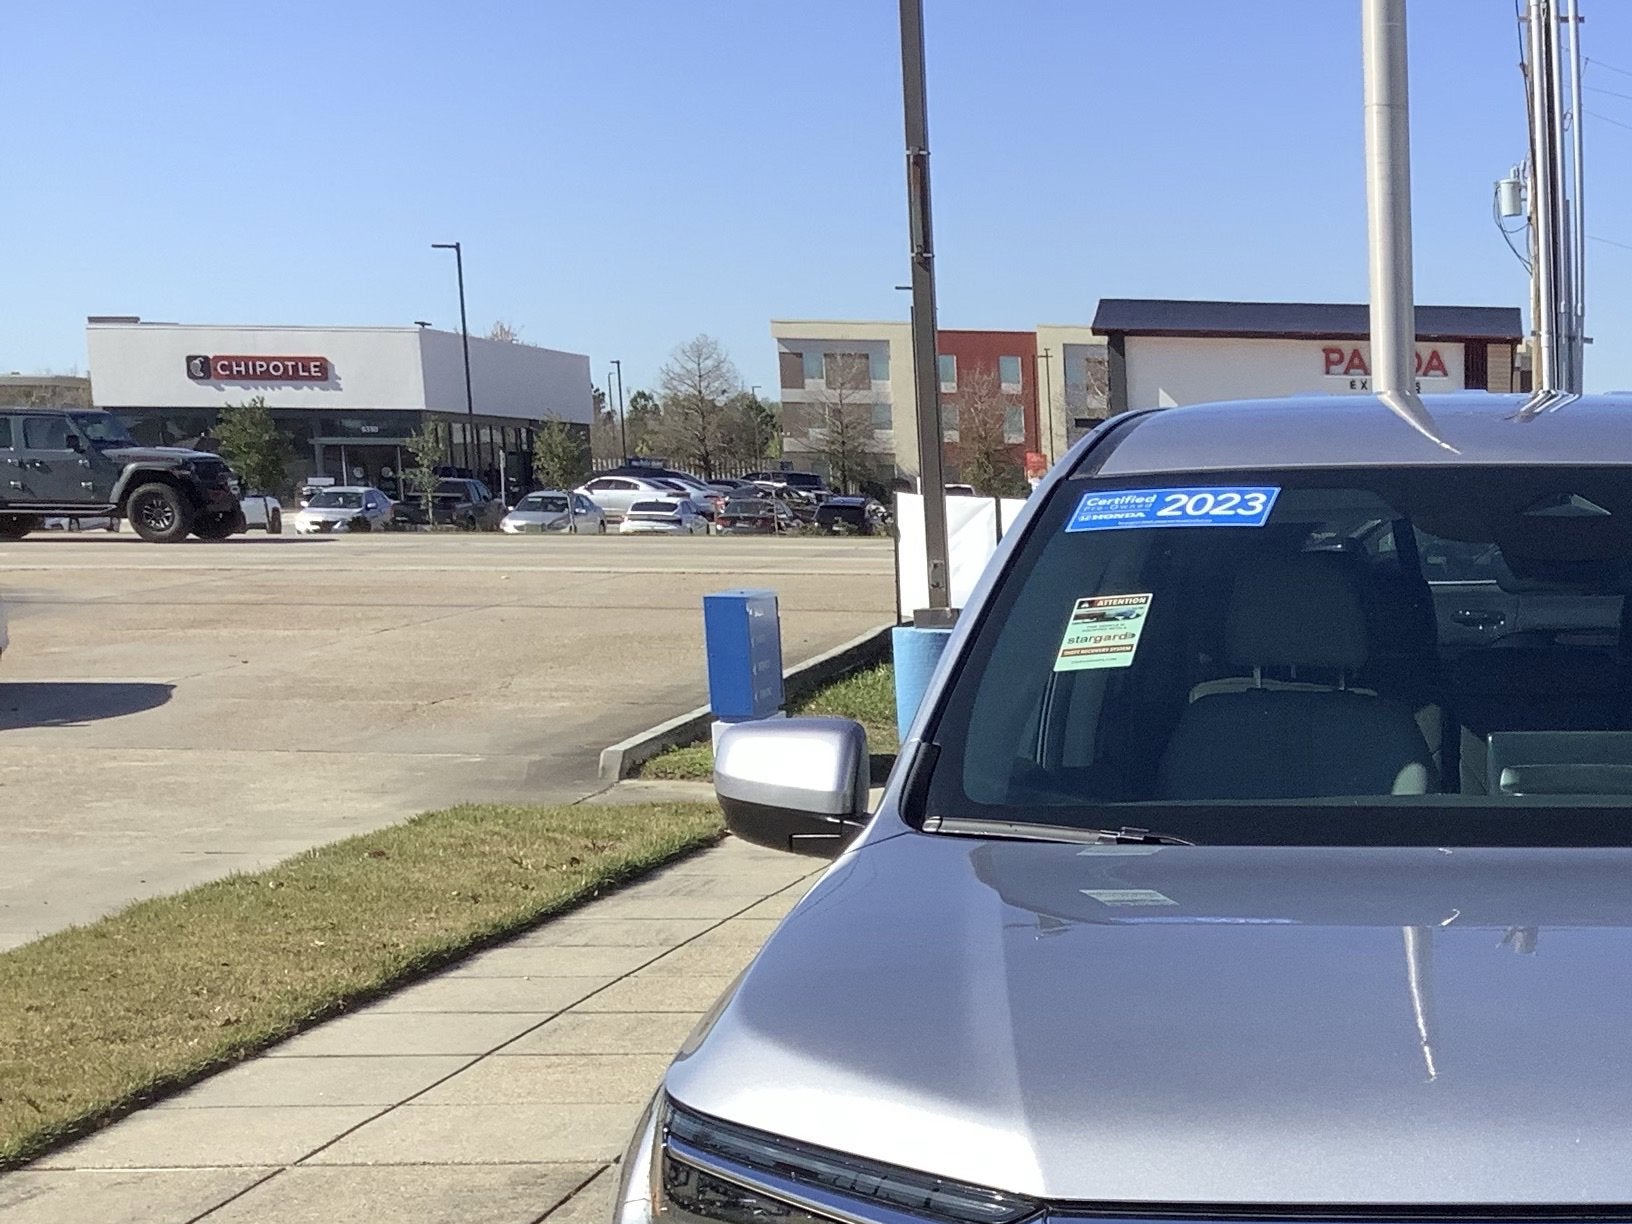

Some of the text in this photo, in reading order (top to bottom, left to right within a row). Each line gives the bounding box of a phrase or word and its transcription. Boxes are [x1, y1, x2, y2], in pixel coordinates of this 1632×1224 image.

[216, 360, 322, 377] CHIPOTLE
[1086, 493, 1157, 507] Certified
[1156, 493, 1267, 517] 2023
[1091, 511, 1146, 520] HONDA
[1097, 596, 1147, 607] ATTENTION
